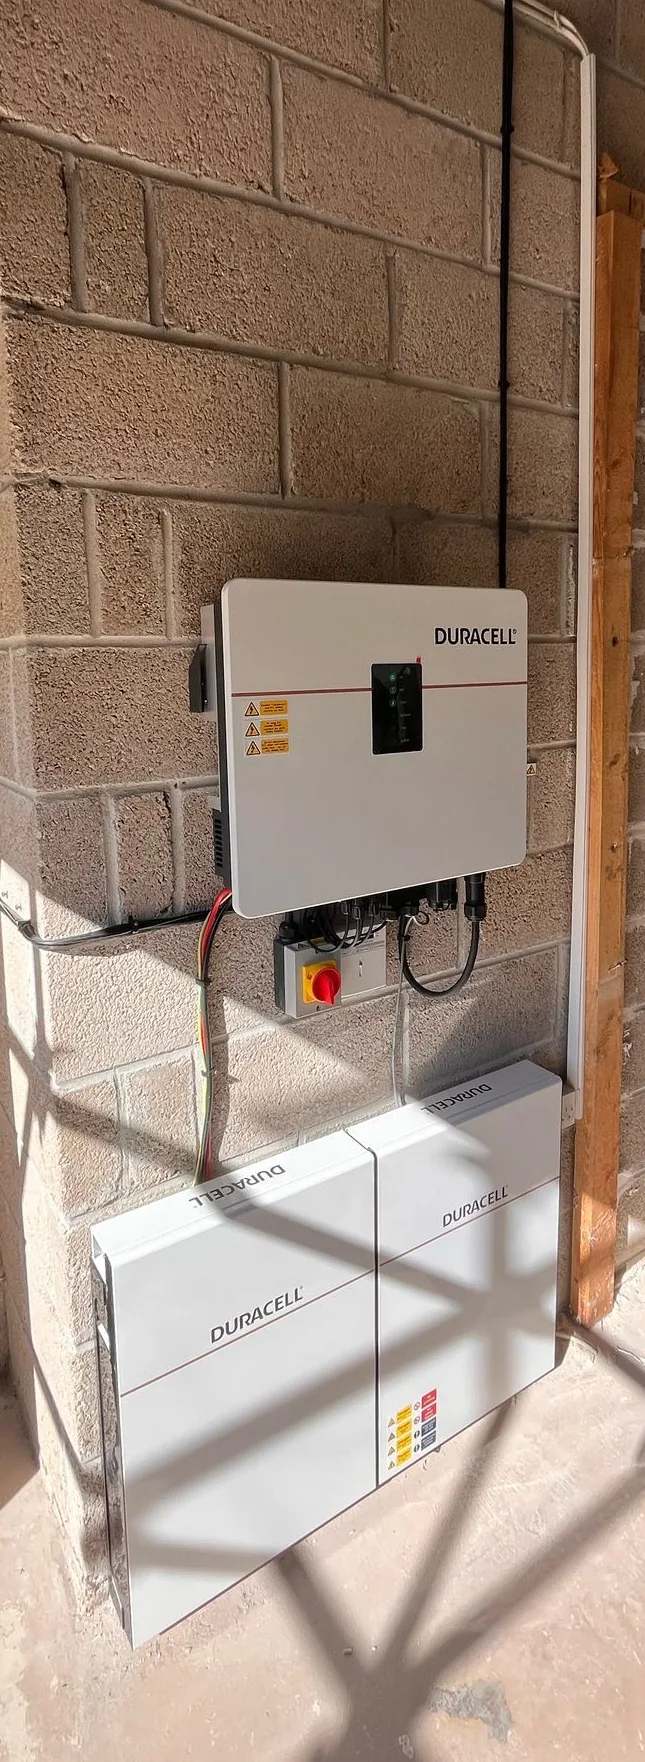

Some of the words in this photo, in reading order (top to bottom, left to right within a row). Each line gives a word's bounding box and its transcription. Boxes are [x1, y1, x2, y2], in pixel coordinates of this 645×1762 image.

[435, 628, 516, 645] DURACELL
[421, 1084, 492, 1114] DURACELL
[188, 1165, 286, 1207] DURACELL
[442, 1185, 508, 1228] DURACELL
[210, 1286, 303, 1344] DURACELL
